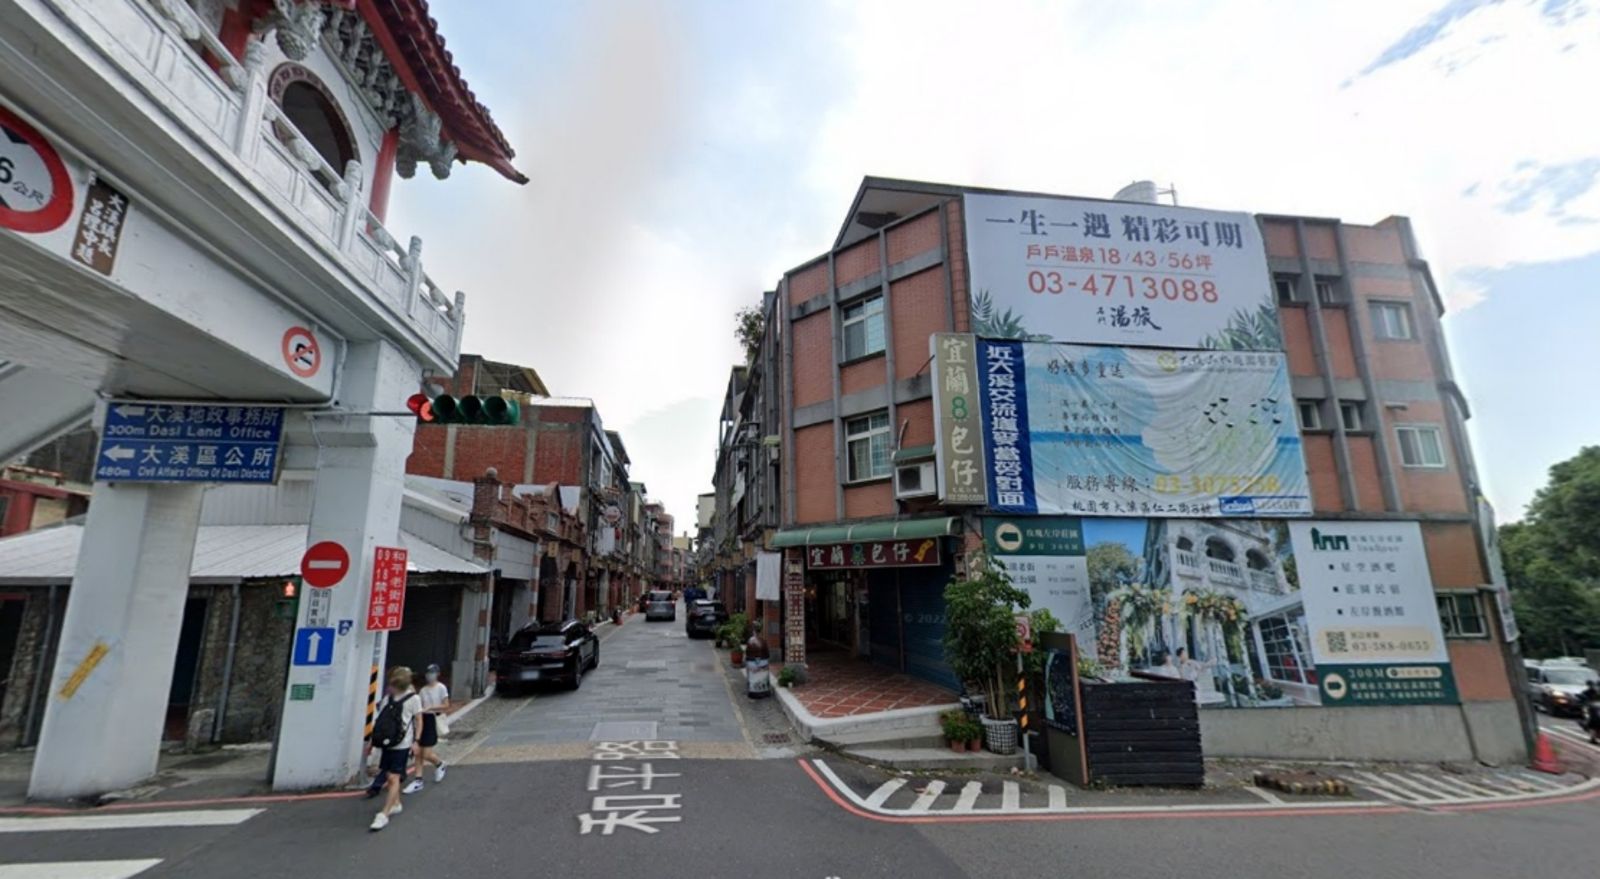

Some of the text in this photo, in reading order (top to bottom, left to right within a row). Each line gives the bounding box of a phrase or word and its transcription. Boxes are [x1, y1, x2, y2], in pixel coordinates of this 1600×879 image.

[985, 209, 1244, 249] 一生一遇 精彩可期
[1028, 270, 1219, 303] 03-4713088
[147, 405, 278, 426] 大溪地政事務所
[107, 425, 145, 436] 300m
[187, 426, 222, 437] Land
[230, 426, 271, 439] Office
[140, 444, 273, 466] 大溪區公所
[98, 466, 131, 477] 480m
[137, 466, 156, 477] Civil
[158, 467, 185, 478] Affairs
[186, 467, 209, 478] Office
[240, 468, 270, 479] District
[386, 551, 406, 627] 和平老街假日
[577, 740, 682, 835] 和平路
